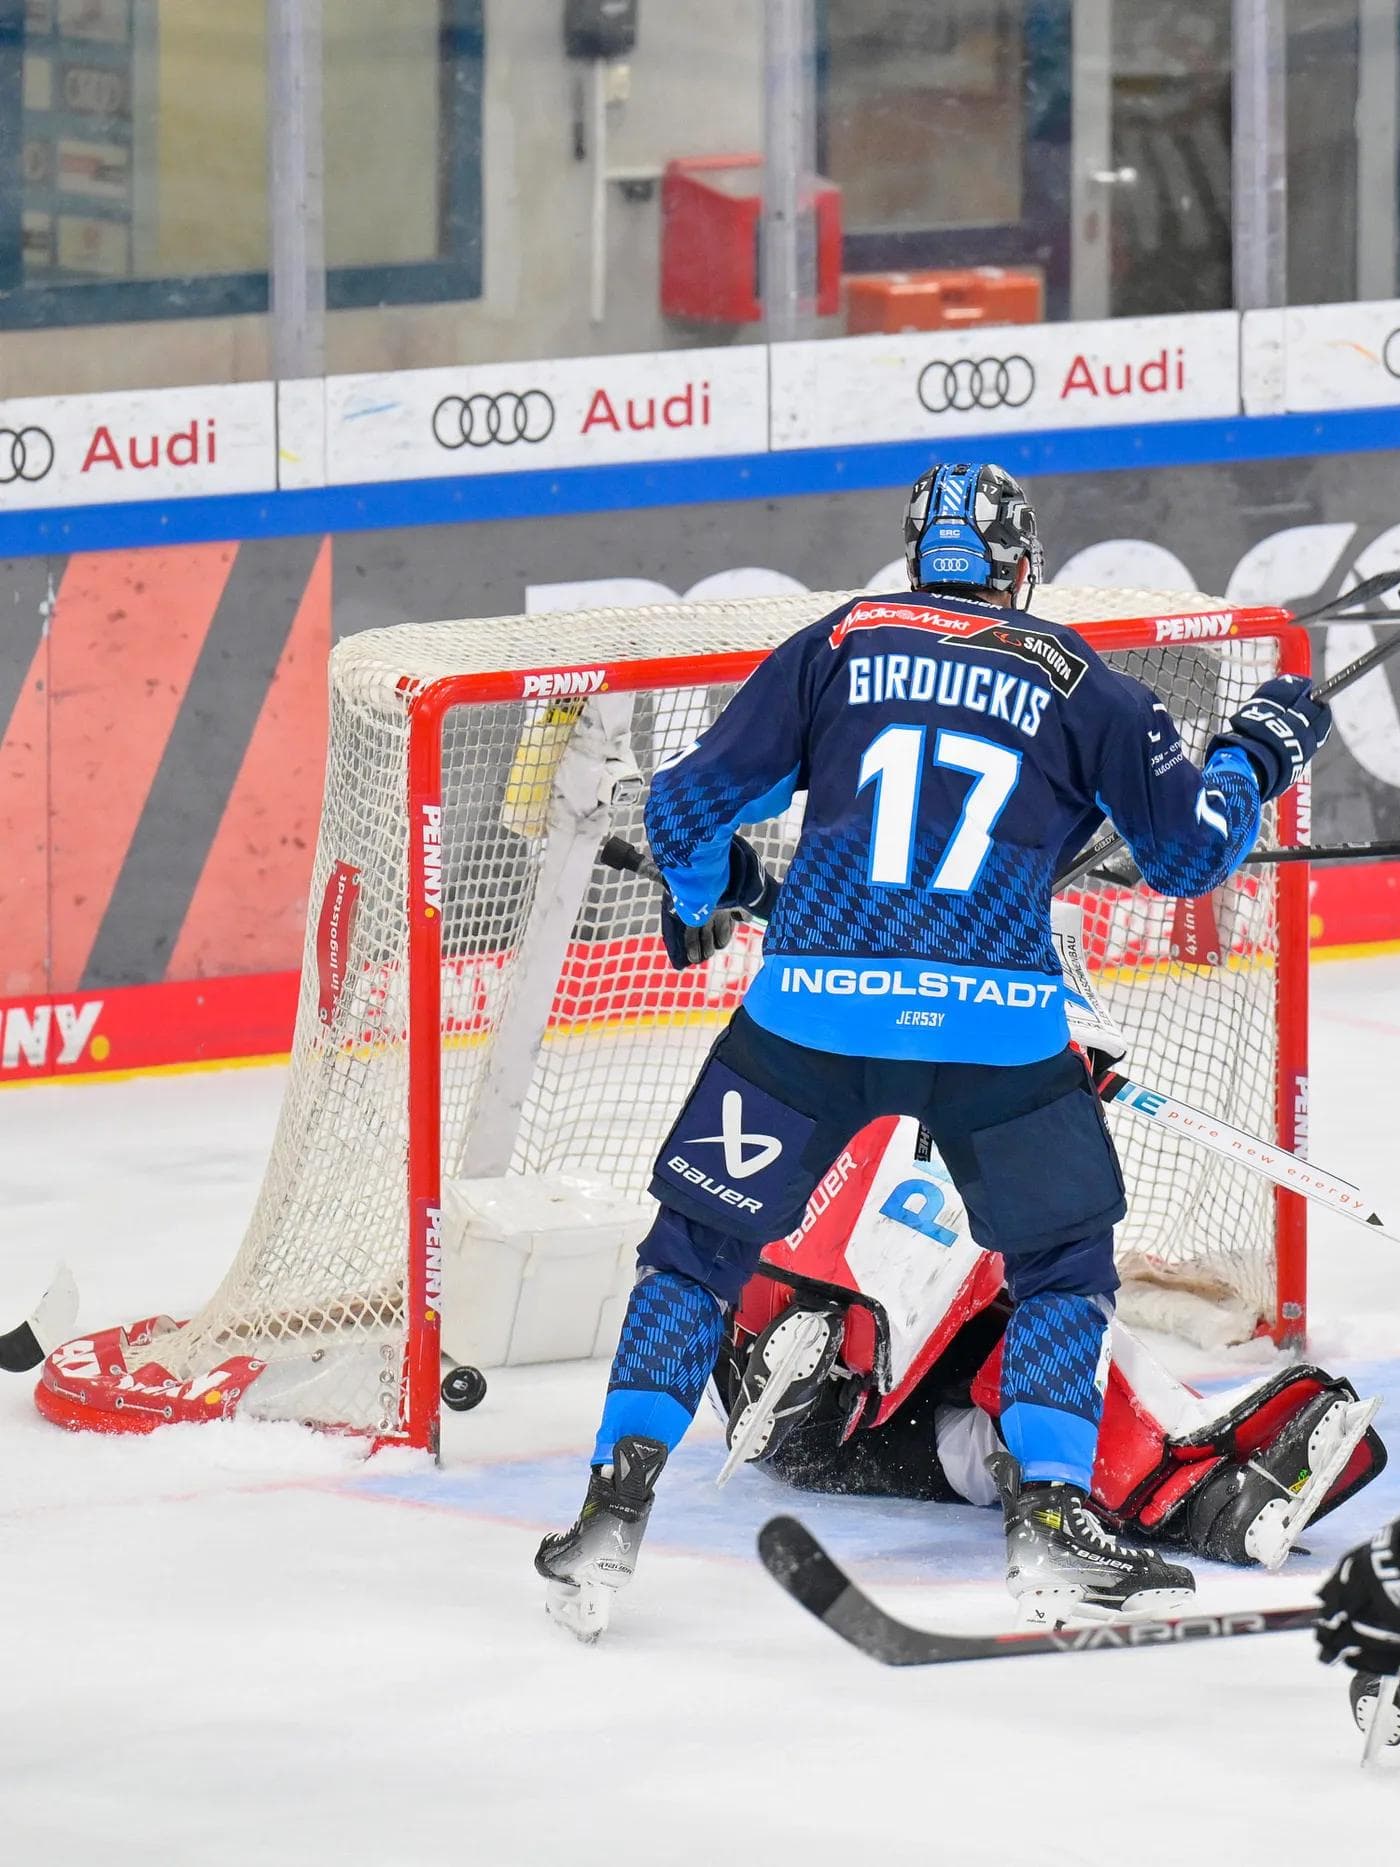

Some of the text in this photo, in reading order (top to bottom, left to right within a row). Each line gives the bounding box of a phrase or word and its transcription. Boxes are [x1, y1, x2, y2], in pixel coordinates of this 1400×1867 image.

[1061, 348, 1185, 398] Audi
[581, 382, 711, 434] Audi
[81, 420, 217, 472] Audi
[914, 481, 927, 492] 17
[982, 483, 998, 495] 17
[939, 529, 961, 537] ERC
[1023, 635, 1071, 681] SATURN
[849, 654, 1051, 738] GIRDUCKIS
[856, 722, 1024, 894] 17
[1296, 767, 1312, 847] ENNY
[329, 873, 347, 969] Ingolstadt
[1184, 937, 1198, 956] 4x
[780, 967, 1057, 1009] INGOLSTADT
[1167, 1109, 1364, 1210] pure new energy
[667, 1155, 765, 1215] BAUER
[1076, 1549, 1135, 1573] BAUER
[1050, 1613, 1266, 1652] VAPOR
